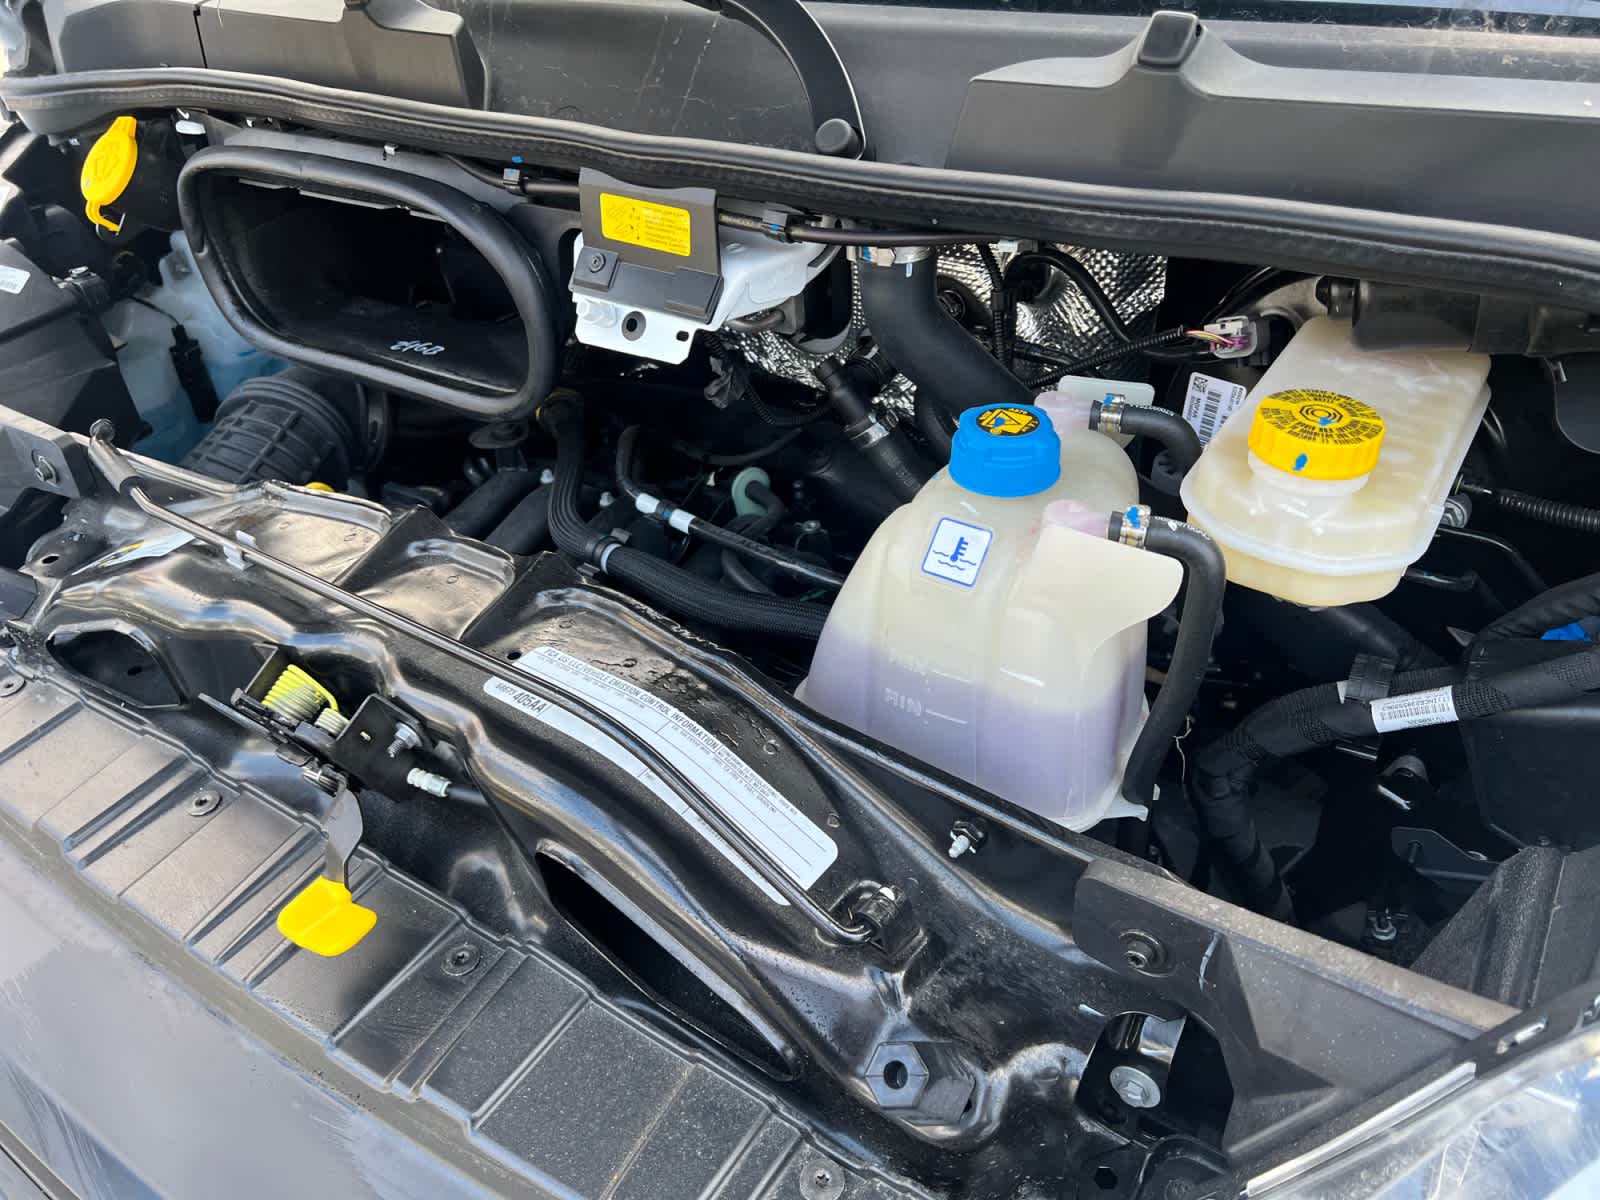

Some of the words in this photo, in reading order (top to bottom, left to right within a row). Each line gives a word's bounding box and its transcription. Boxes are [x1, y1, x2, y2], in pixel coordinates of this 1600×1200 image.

[544, 647, 558, 658] FCA
[558, 653, 568, 663] US
[568, 658, 581, 669] LLC
[582, 664, 609, 683] VEHICLE
[609, 676, 641, 699] EMISSION
[640, 692, 670, 717] CONTROL
[670, 710, 719, 750] INFORMATION
